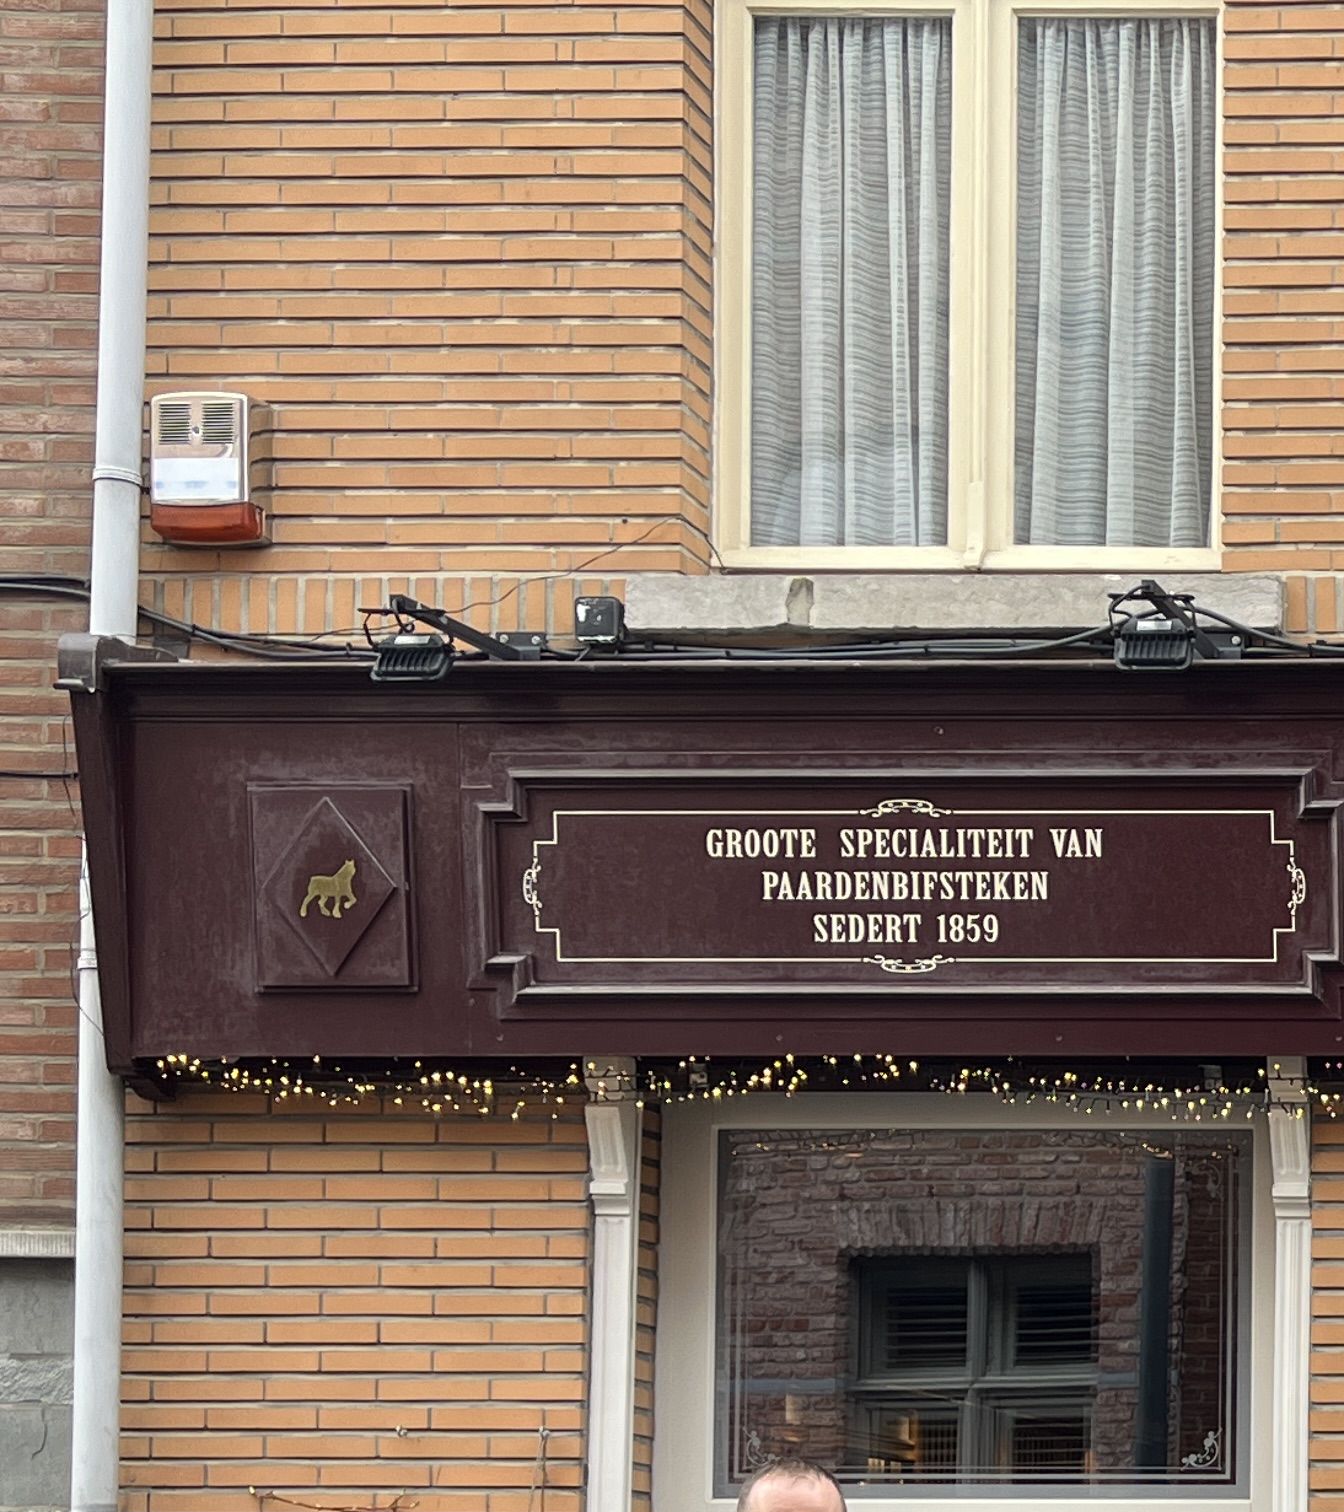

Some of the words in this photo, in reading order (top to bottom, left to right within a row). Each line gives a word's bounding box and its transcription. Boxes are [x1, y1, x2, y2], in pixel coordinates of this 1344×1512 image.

[706, 828, 817, 858] GROOTE
[839, 828, 1034, 858] SPECIALITEIT
[1048, 828, 1103, 858] VAN
[761, 870, 1049, 901] PAARDENBIFSTEKEN
[813, 913, 922, 943] SEDERT
[936, 913, 999, 943] 1859
